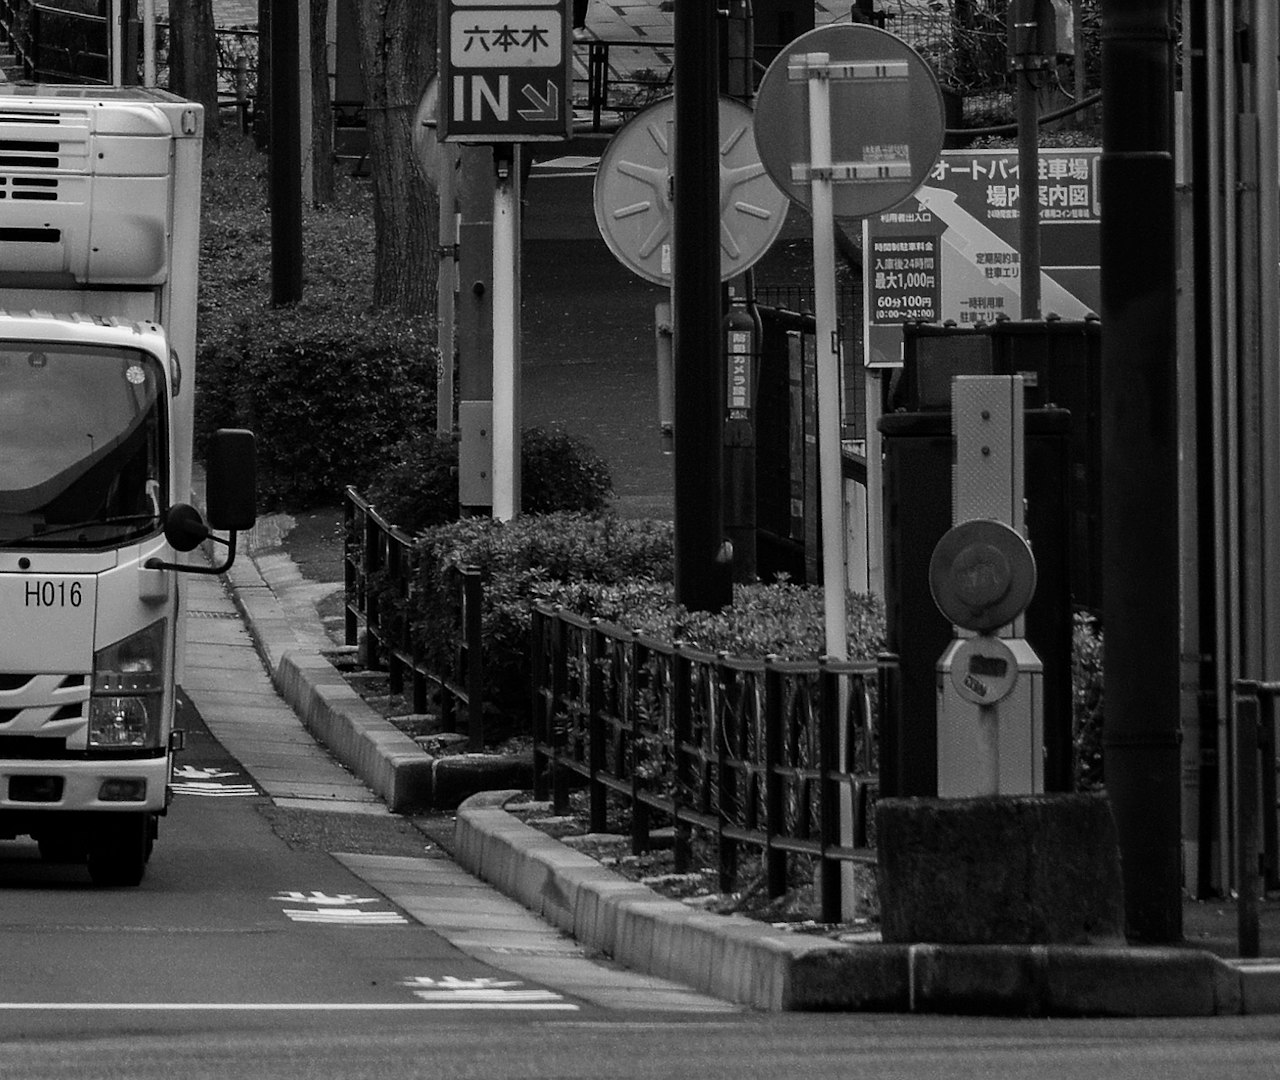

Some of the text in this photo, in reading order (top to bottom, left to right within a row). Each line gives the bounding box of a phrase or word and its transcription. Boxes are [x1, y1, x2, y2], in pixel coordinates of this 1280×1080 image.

[463, 25, 549, 52] 六本木
[453, 74, 509, 121] IN
[880, 213, 932, 223] 利用者出入口
[875, 257, 934, 271] 入庫後24時間
[875, 272, 935, 290] 最大1,000円
[877, 297, 932, 309] 60分100円
[24, 581, 82, 607] H016
